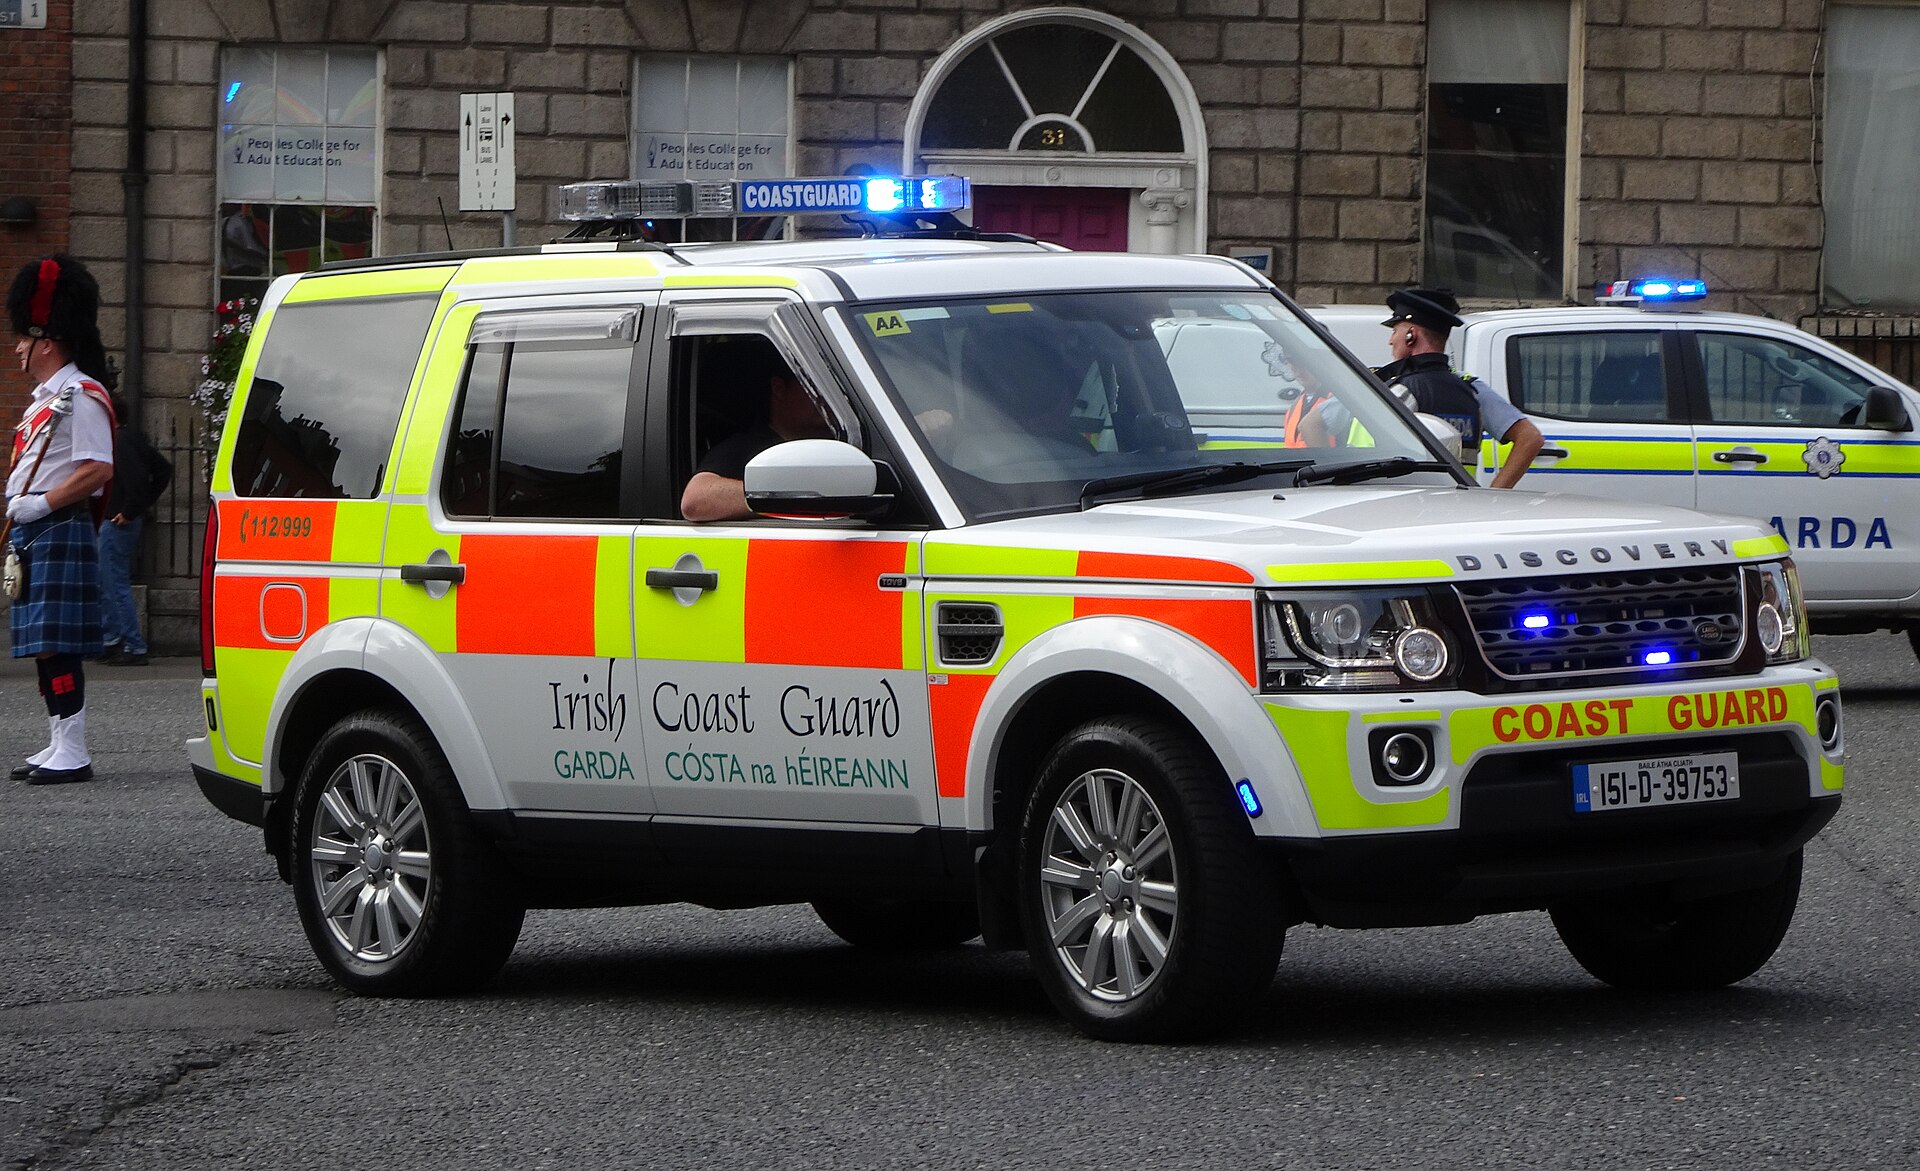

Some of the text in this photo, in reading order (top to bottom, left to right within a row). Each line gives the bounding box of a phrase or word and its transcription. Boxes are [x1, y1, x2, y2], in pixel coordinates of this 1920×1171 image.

[296, 139, 340, 153] College
[343, 139, 360, 151] for
[708, 143, 752, 157] College
[754, 144, 773, 155] for
[247, 154, 342, 166] Adut Educaton
[660, 159, 753, 171] Adut Educaton
[745, 184, 861, 208] COASTGUARD
[876, 315, 903, 331] AA
[251, 515, 312, 537] 112/999
[1769, 516, 1892, 549] ARDA
[1456, 539, 1728, 571] DISCOVERY
[549, 658, 900, 743] Irish Coast Guard
[1492, 687, 1788, 743] COAST GUARD
[554, 742, 909, 789] GARDA CÓSTA na hÉIREANN
[1638, 761, 1655, 770] BAILE
[1673, 759, 1693, 768] CLIATH
[1600, 765, 1728, 806] 151-D-39753
[1576, 793, 1589, 804] IRL
